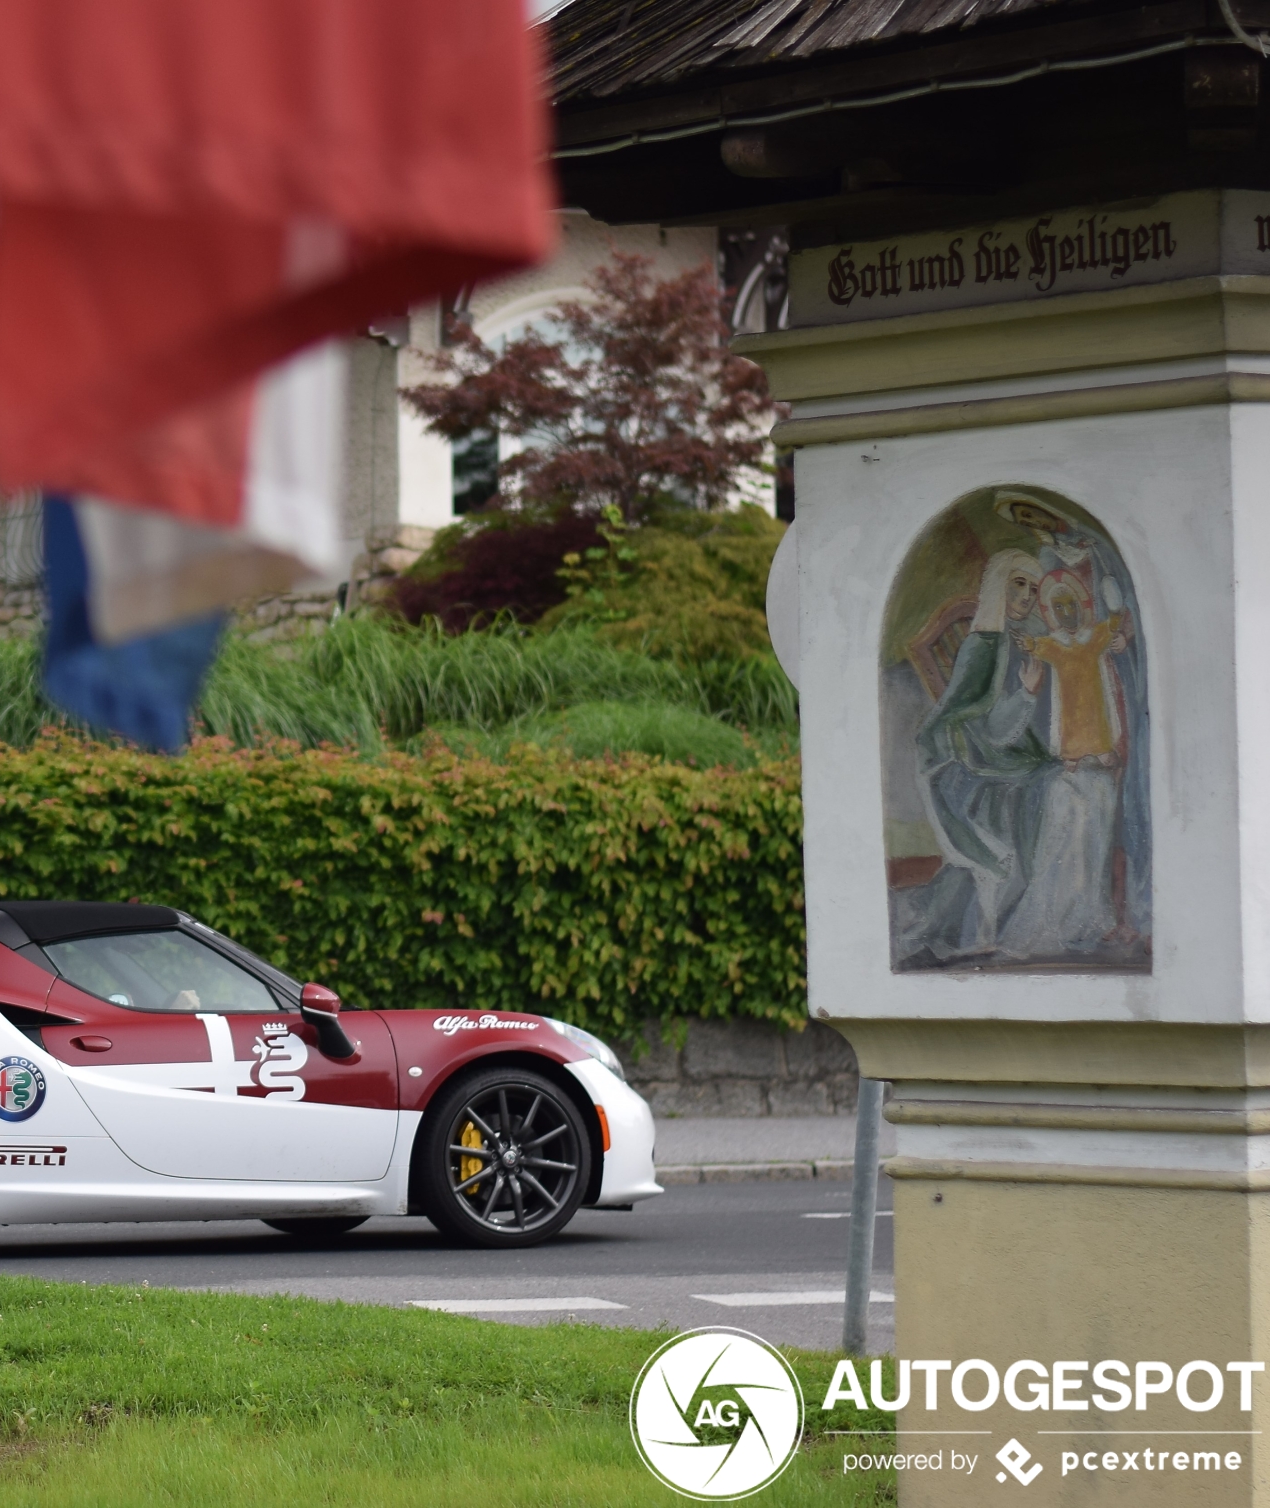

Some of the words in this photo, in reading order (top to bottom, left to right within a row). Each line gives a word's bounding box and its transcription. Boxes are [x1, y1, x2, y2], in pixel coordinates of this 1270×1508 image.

[828, 245, 903, 308] Gott
[906, 237, 965, 292] und
[974, 231, 1021, 285] die
[1026, 214, 1177, 291] Heiligen
[433, 1016, 478, 1036] Alfa
[479, 1014, 539, 1030] Romeo
[10, 1057, 45, 1090] ROMEO
